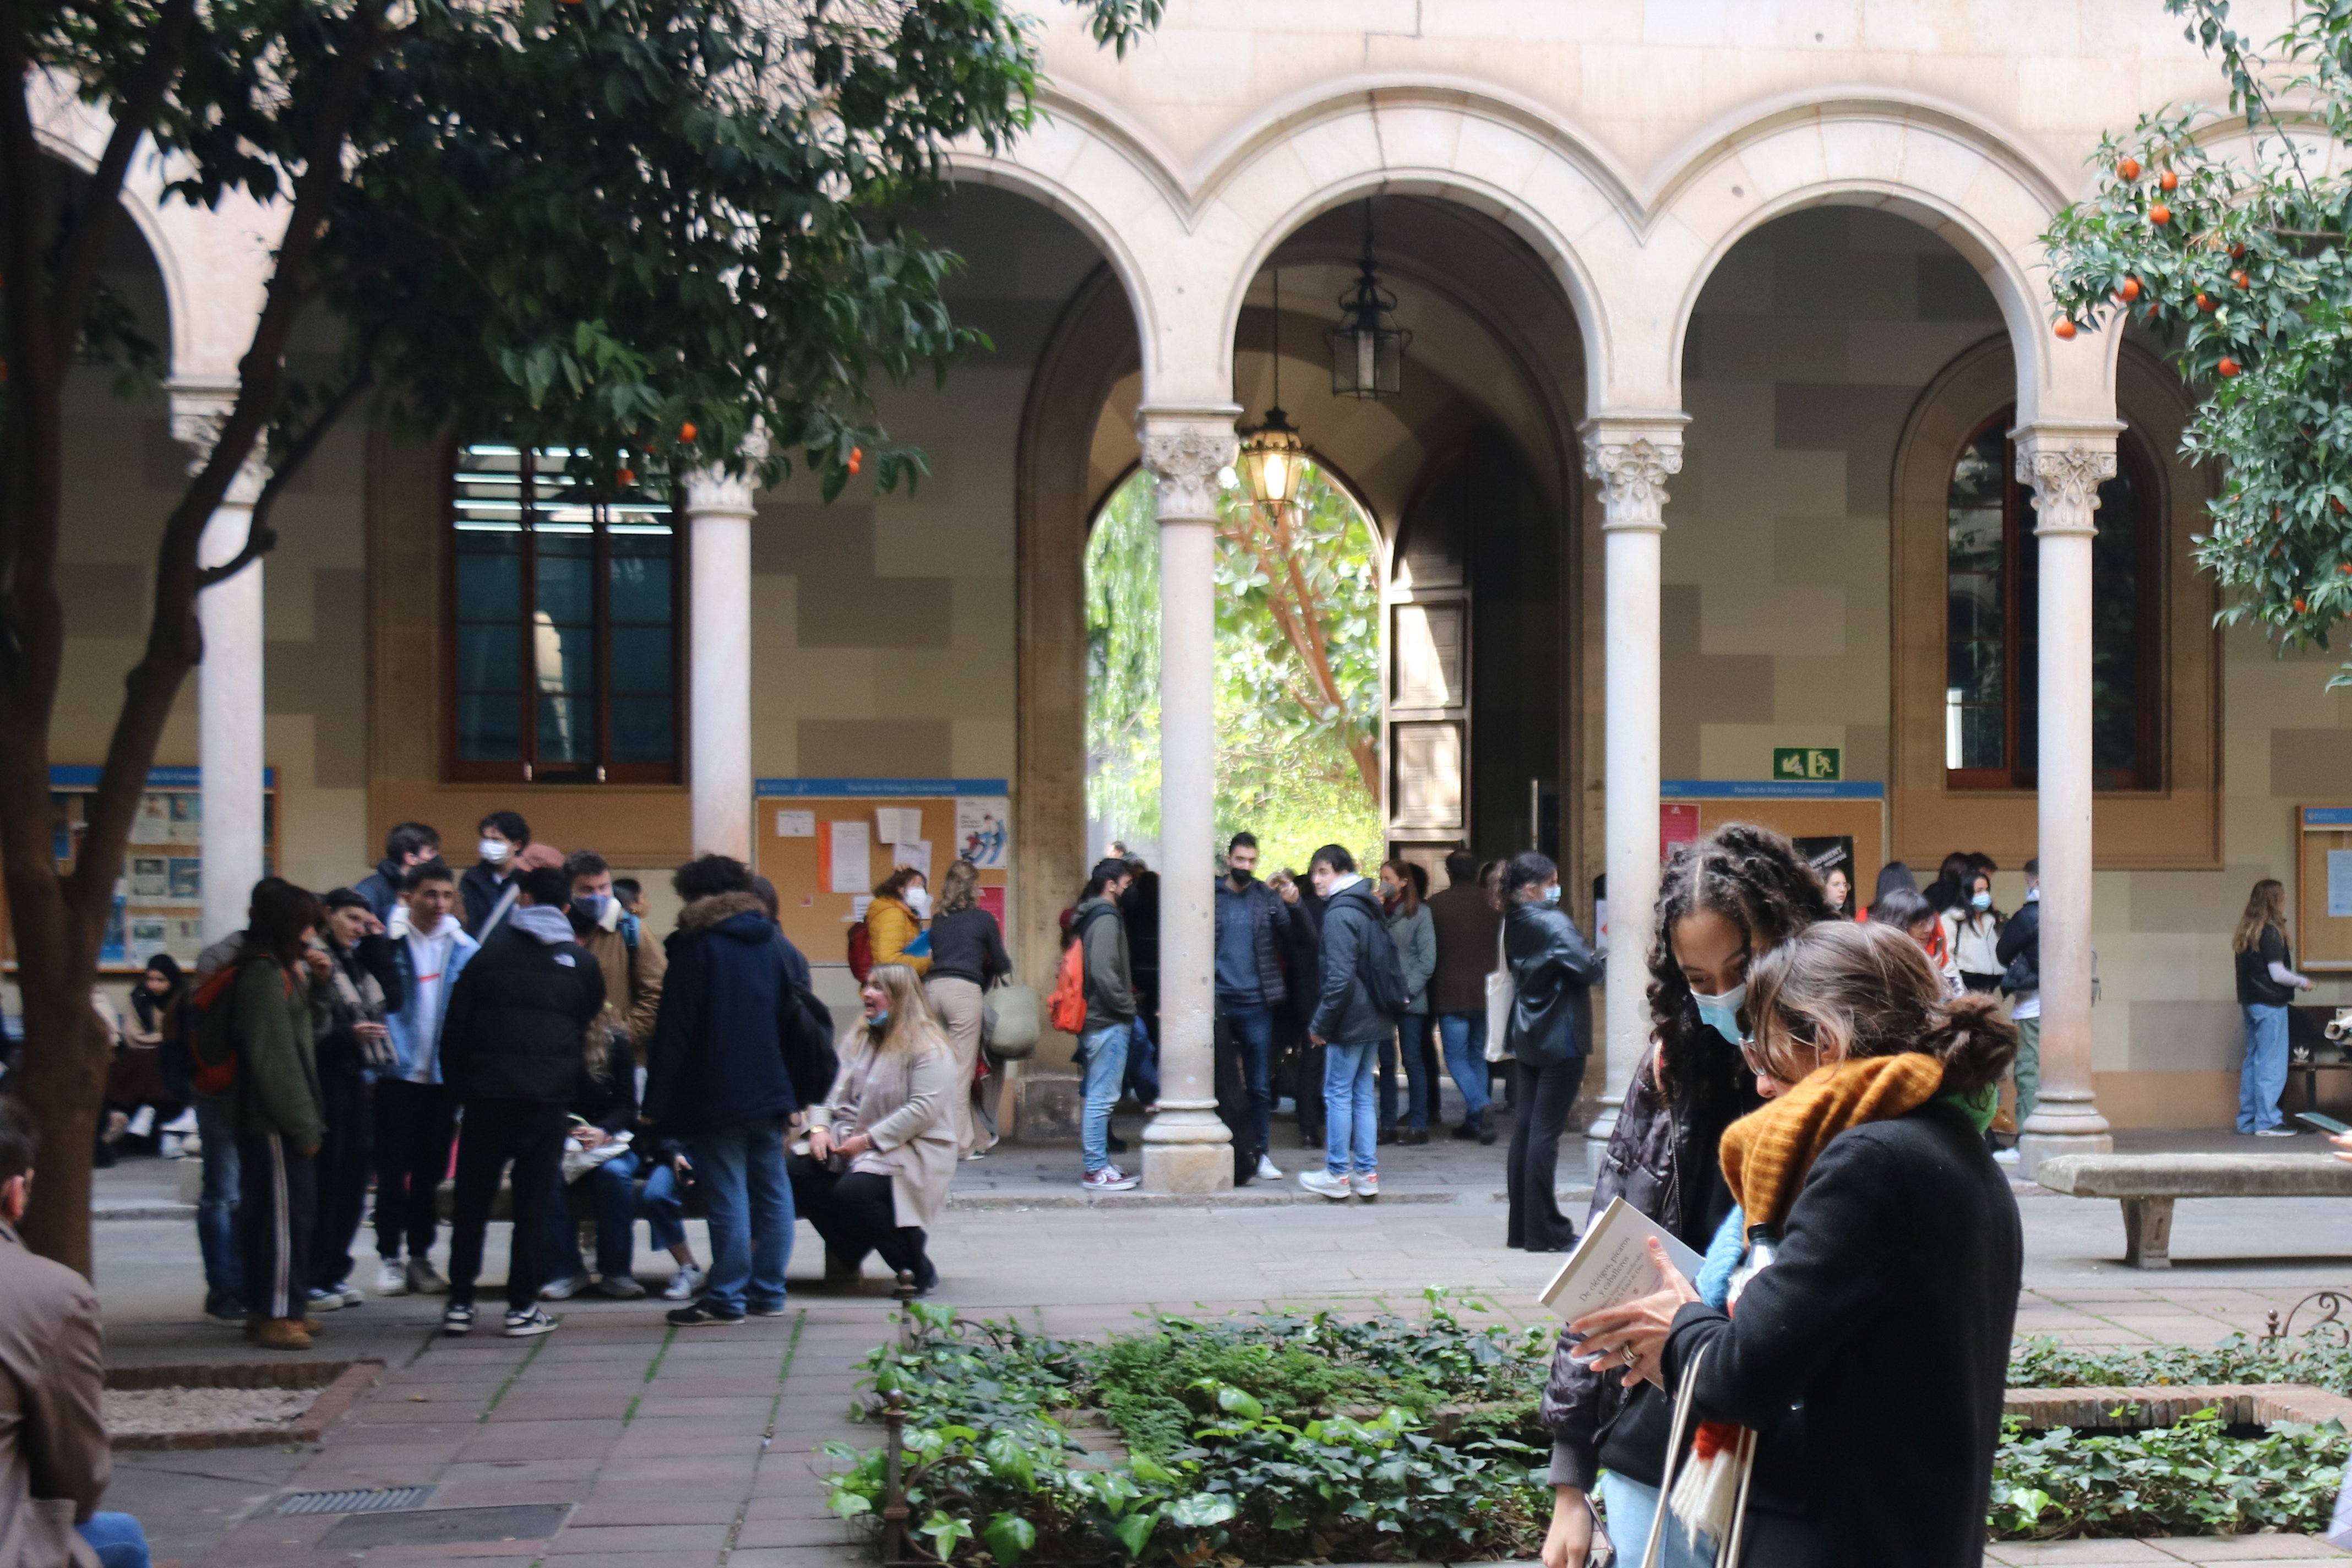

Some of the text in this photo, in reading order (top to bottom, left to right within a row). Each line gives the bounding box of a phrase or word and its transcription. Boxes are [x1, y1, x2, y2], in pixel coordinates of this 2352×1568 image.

[1579, 1237, 1631, 1302] De clérigos, pícaros
[1604, 1256, 1630, 1290] caballeros
